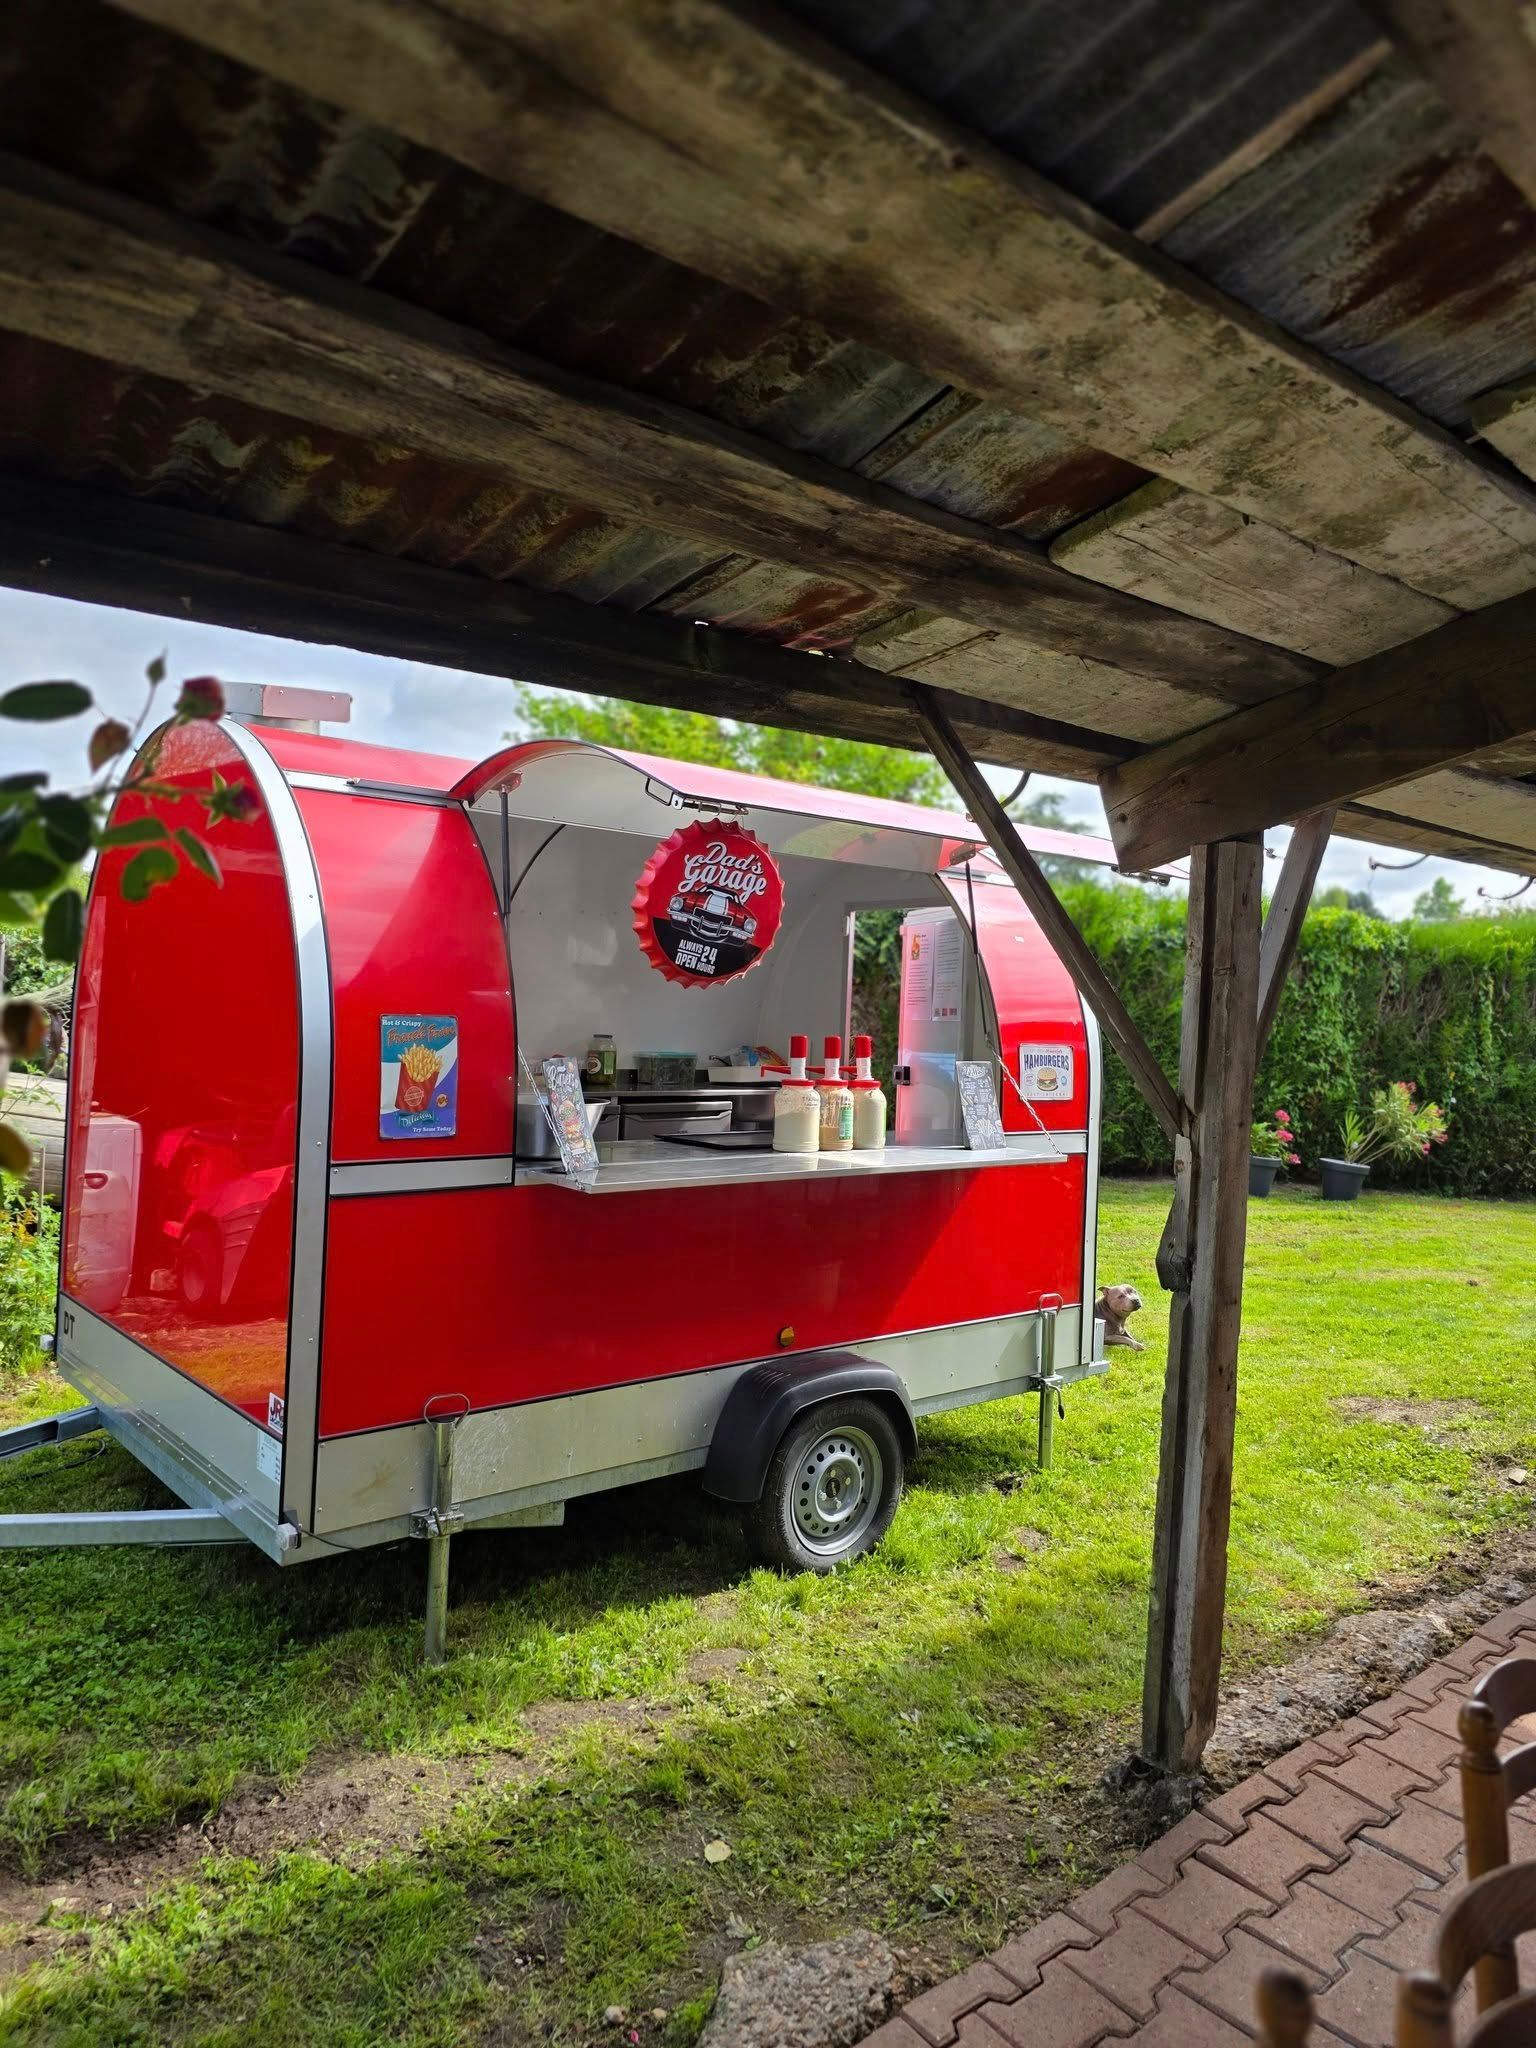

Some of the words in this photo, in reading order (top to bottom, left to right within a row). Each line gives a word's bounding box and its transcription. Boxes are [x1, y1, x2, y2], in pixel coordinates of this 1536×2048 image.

[694, 841, 764, 875] Dad's
[678, 854, 767, 904] Garage
[675, 952, 698, 969] OPEN
[696, 962, 715, 974] HOURS
[679, 939, 703, 953] ALWAYS
[701, 946, 717, 964] 24
[401, 1019, 422, 1027] Crispy
[1023, 1054, 1070, 1071] HAMBURGERS
[63, 1310, 75, 1340] DT
